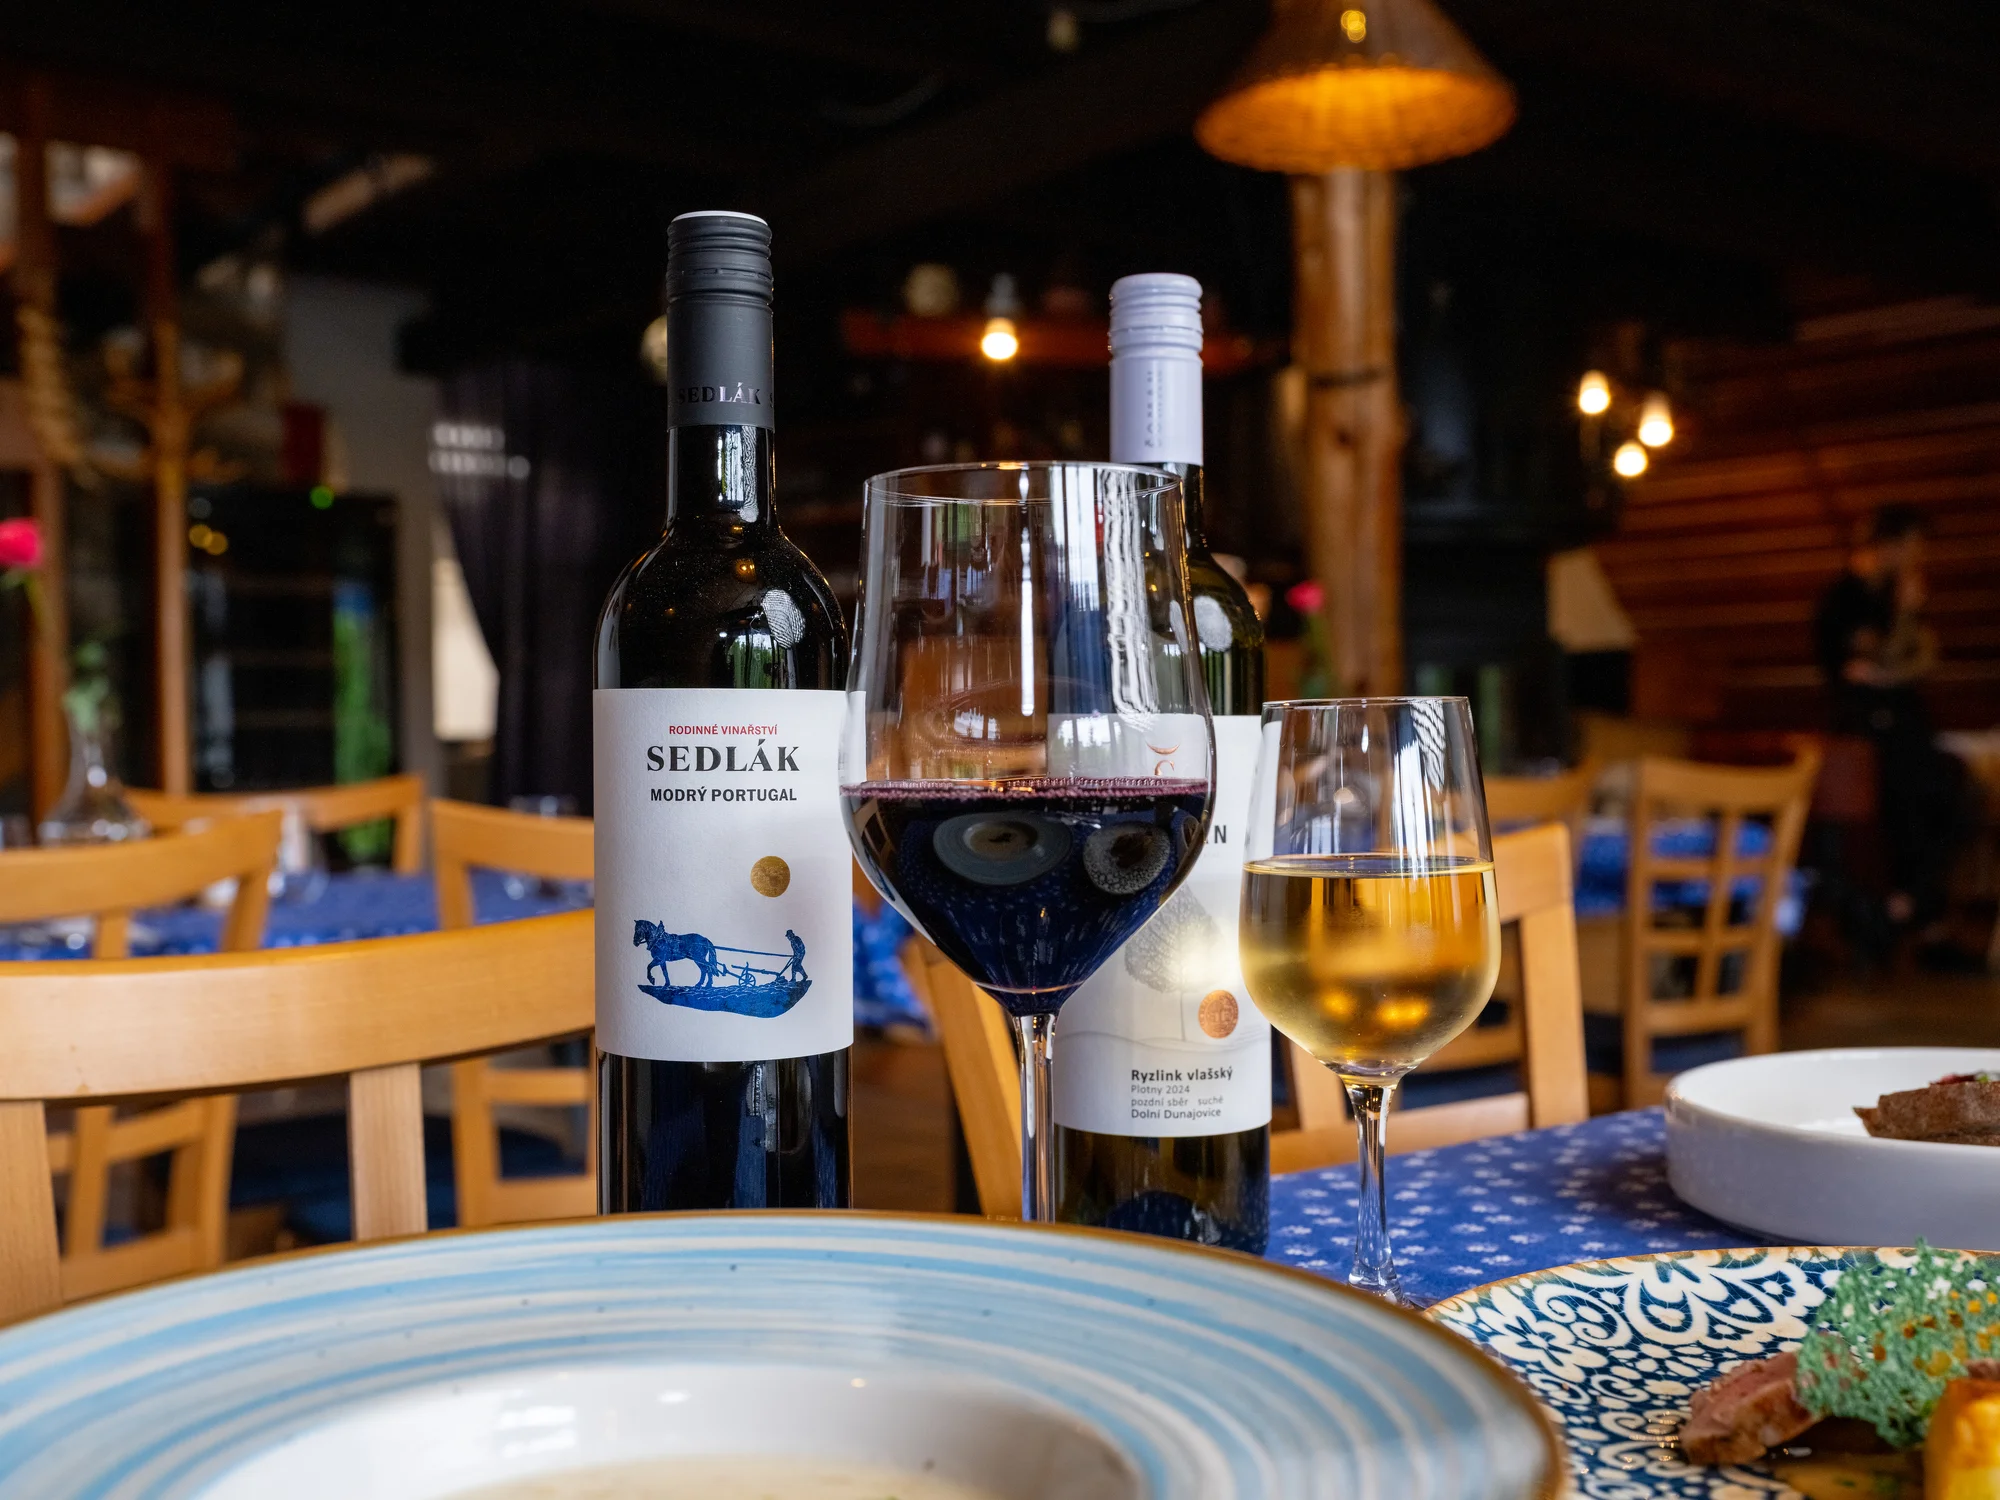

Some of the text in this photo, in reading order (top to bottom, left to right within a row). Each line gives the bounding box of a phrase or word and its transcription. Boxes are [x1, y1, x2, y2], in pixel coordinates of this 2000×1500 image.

[678, 382, 761, 404] SEDLÁK
[669, 724, 778, 735] RODINNÉ VINAŘSTVÍ
[647, 739, 800, 771] SEDLÁK
[650, 786, 797, 802] MODRÝ PORTUGAL
[1131, 1066, 1233, 1083] Ryzlink vlašský
[1131, 1084, 1190, 1095] Plotny 2024
[1131, 1095, 1223, 1107] pozdní sběr suché
[1131, 1108, 1221, 1120] Dolní Dunajovice
